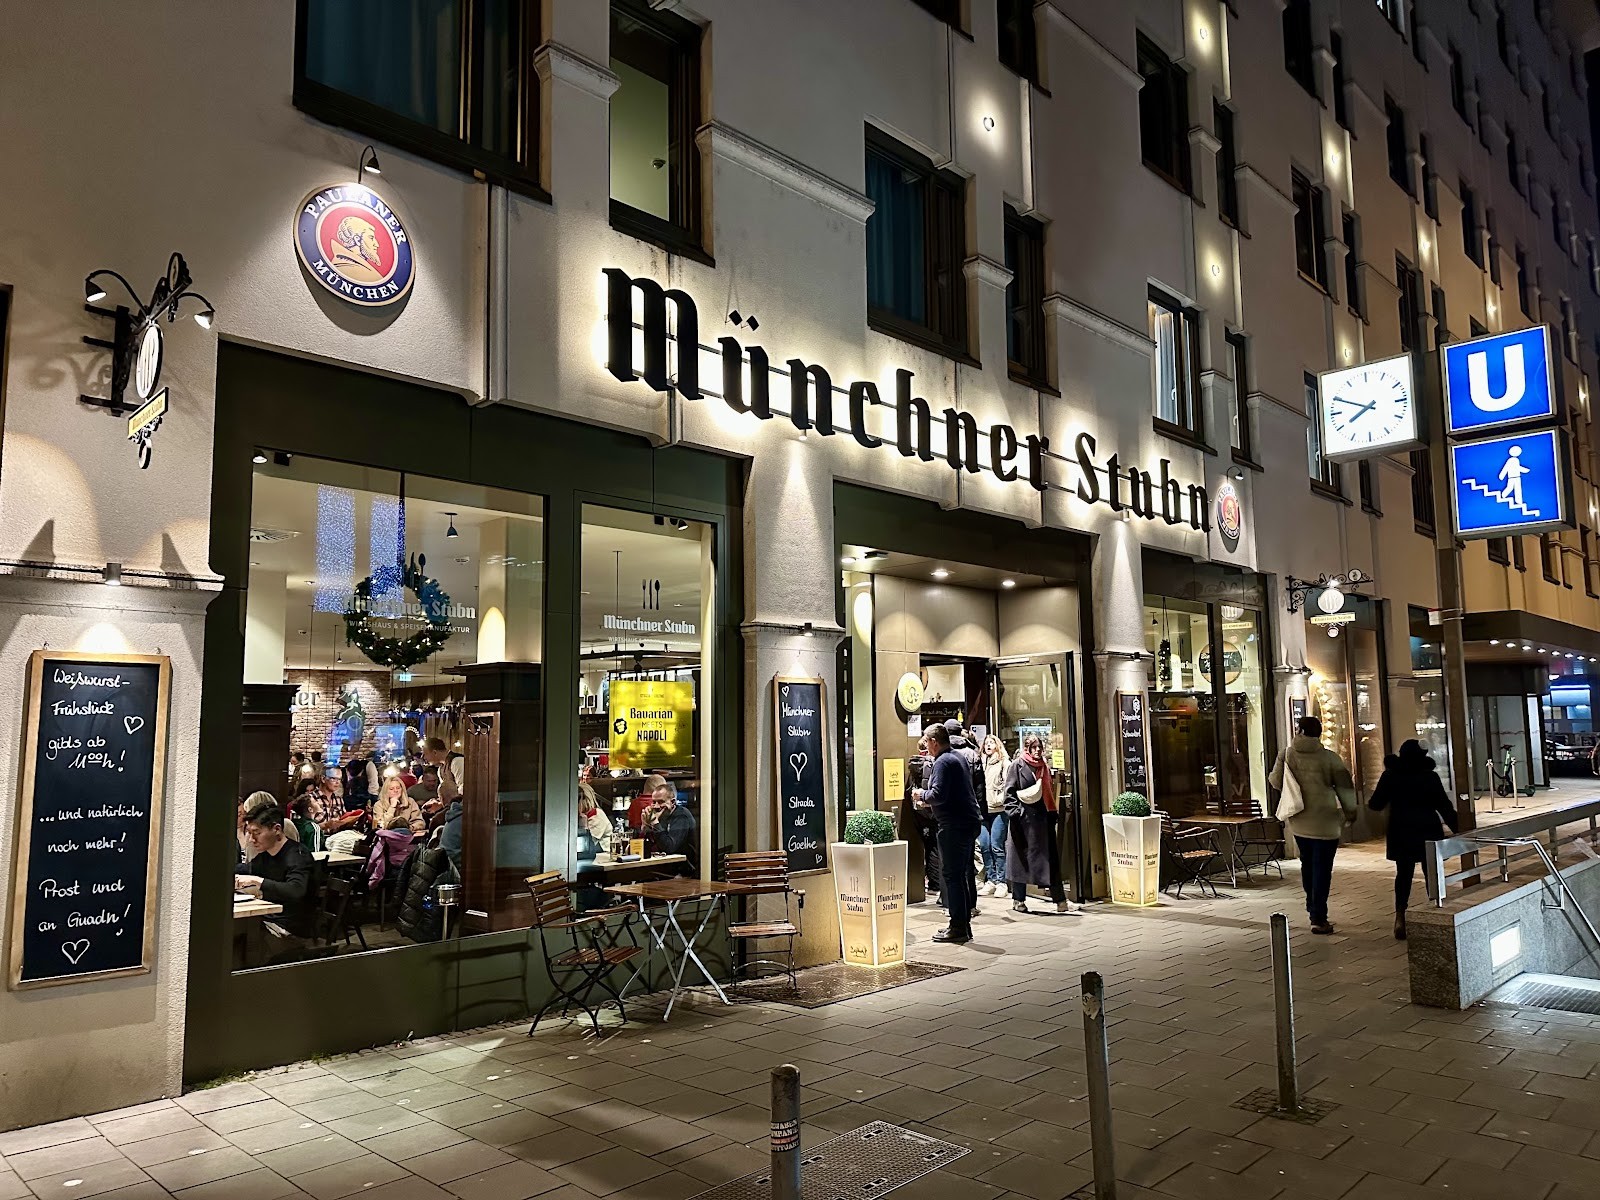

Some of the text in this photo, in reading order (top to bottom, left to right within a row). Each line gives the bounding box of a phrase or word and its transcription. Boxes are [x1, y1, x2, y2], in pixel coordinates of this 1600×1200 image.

[312, 259, 400, 300] MÜNCHEN
[1467, 343, 1526, 412] U
[602, 267, 1211, 534] Münchner Stubn
[432, 599, 477, 620] Stubn
[604, 614, 696, 635] Münchner Stubn
[641, 721, 663, 729] MEETS
[86, 736, 107, 748] ab
[637, 729, 667, 742] NAPOLI
[788, 796, 816, 809] Strada
[87, 803, 144, 818] natürlich
[795, 813, 808, 826] del
[47, 839, 80, 853] noch
[788, 835, 818, 852] Goethe
[39, 878, 125, 899] Prost und
[38, 921, 57, 933] an
